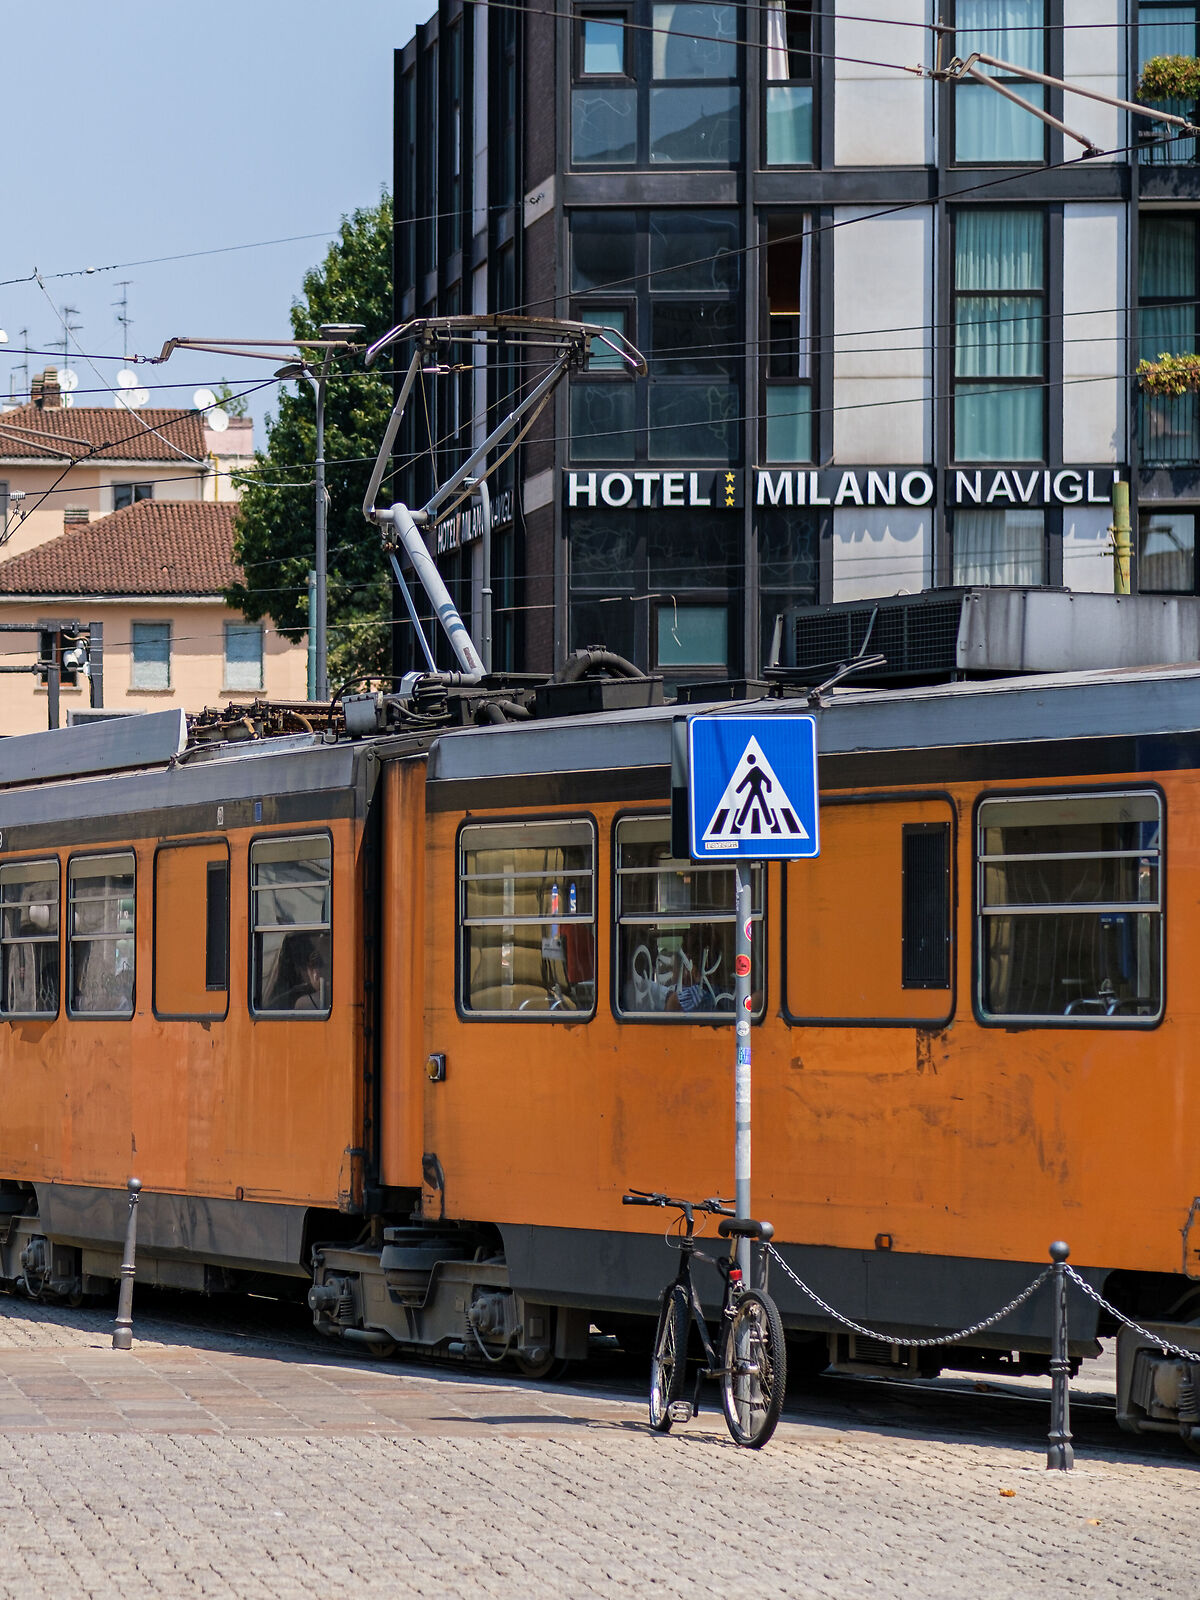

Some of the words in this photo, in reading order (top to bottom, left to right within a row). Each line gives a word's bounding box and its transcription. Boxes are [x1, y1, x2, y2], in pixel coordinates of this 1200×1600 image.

[569, 472, 711, 506] HOTEL
[757, 471, 934, 506] MILANO
[438, 518, 456, 554] HOTEL
[462, 504, 484, 544] MILAN
